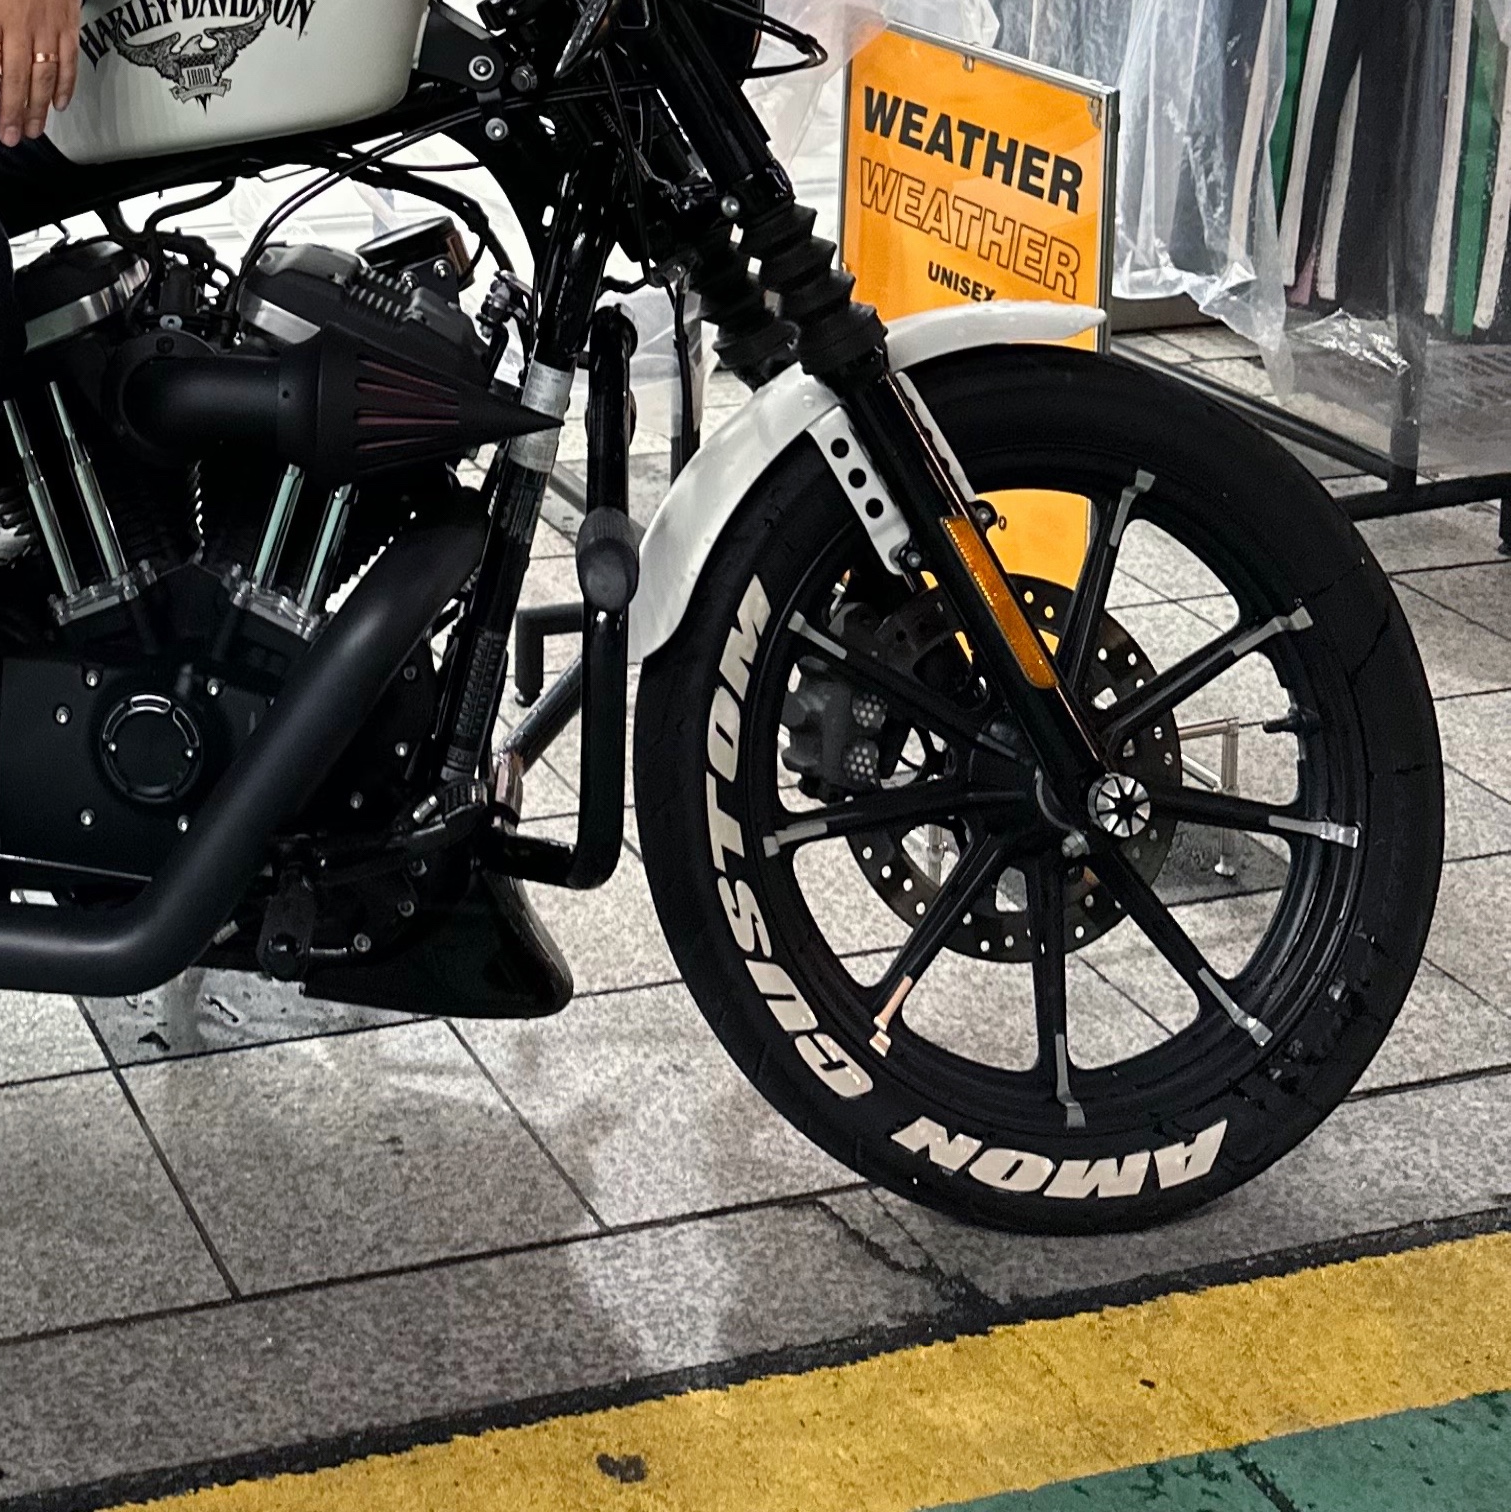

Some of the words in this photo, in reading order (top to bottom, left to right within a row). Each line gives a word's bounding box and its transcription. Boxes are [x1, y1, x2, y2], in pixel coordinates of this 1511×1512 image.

[864, 85, 1083, 215] WEATHER
[860, 156, 1081, 301] WEATHER
[927, 260, 996, 303] UNISEX
[705, 574, 874, 1099] CUSTOM
[890, 1115, 1228, 1200] AMON
